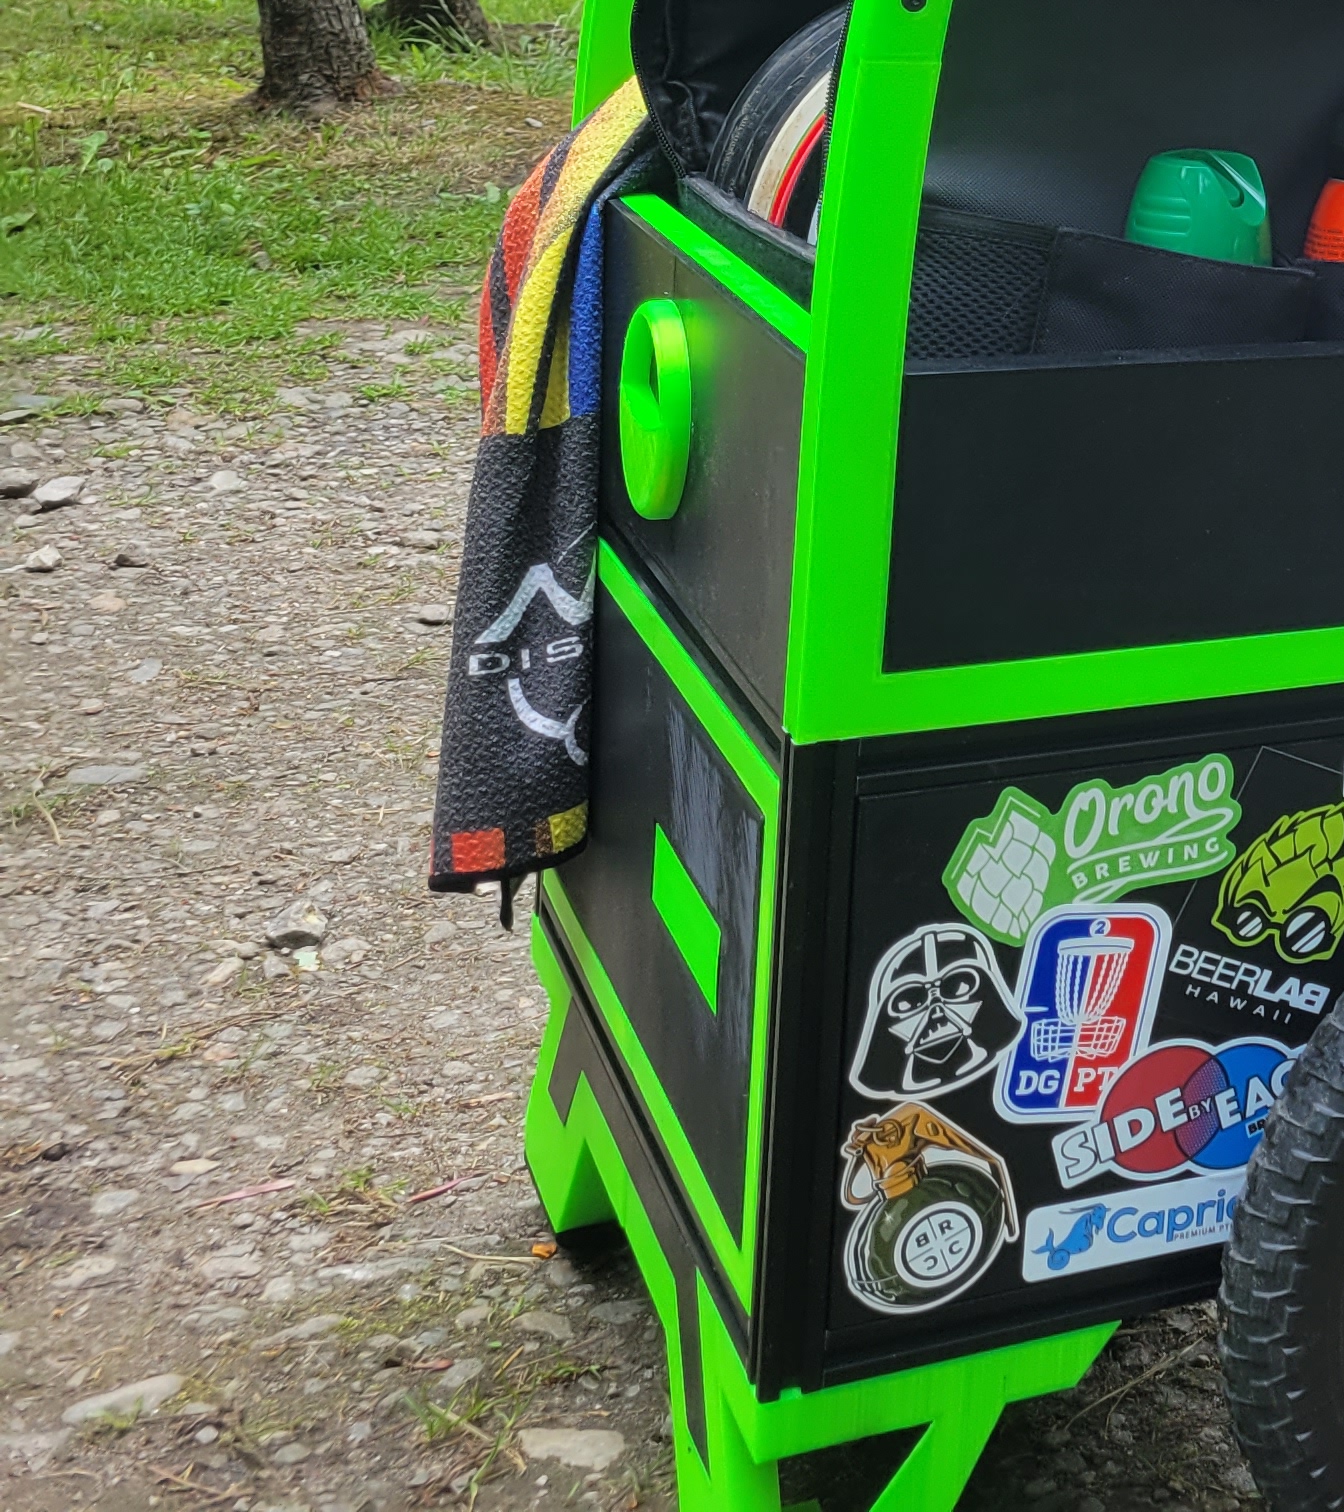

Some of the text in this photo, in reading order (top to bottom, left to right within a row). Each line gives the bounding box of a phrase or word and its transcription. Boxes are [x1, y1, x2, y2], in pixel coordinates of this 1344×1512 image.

[1064, 761, 1228, 859] Orono
[1071, 836, 1220, 890] BREWING
[1094, 920, 1107, 935] 2
[1185, 984, 1292, 1025] HAWAII
[1015, 1069, 1061, 1096] DG
[1060, 1087, 1189, 1180] SIDE
[1187, 1096, 1213, 1121] BY
[1173, 1226, 1216, 1241] PREMIUM
